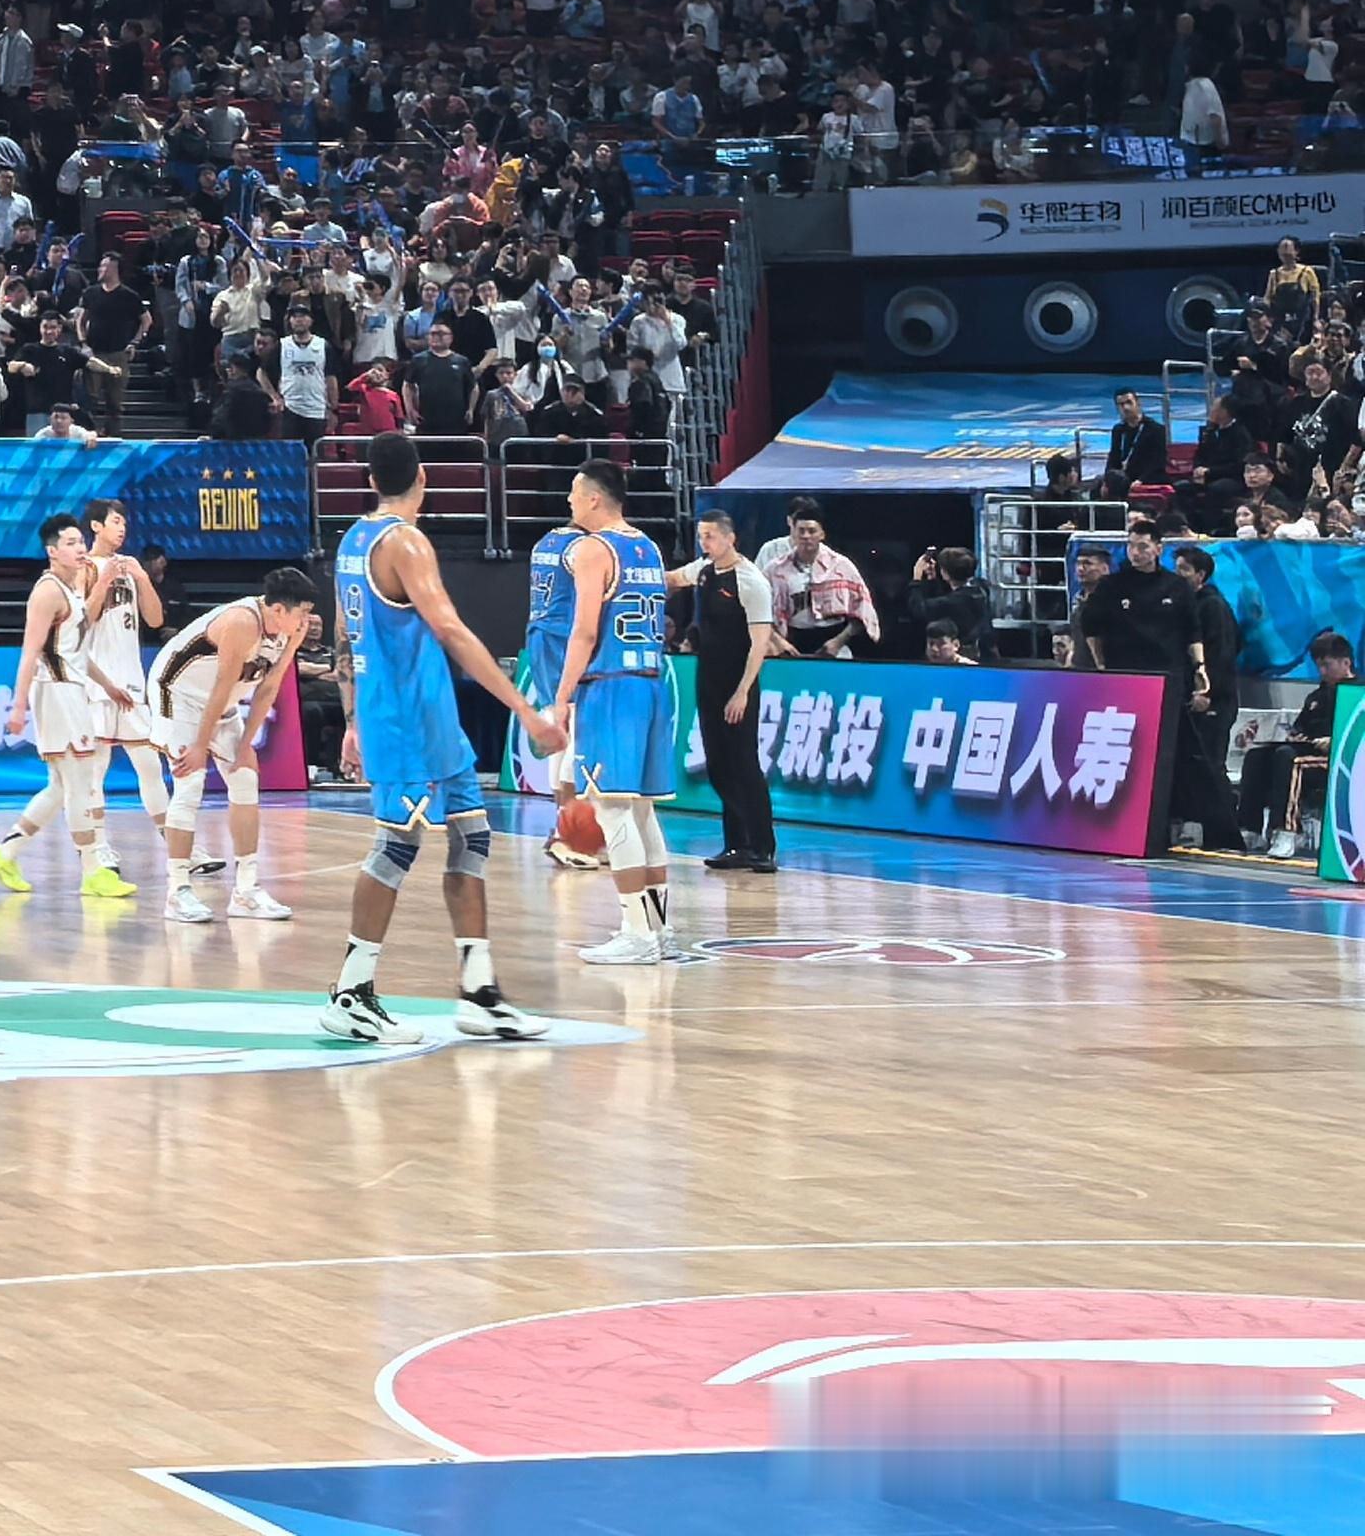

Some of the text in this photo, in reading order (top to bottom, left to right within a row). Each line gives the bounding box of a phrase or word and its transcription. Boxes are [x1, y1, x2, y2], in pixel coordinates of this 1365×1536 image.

[1019, 192, 1336, 224] 华熙生物 润百颜ECM中心
[198, 487, 260, 532] BEIJING
[901, 697, 1138, 810] 中国人寿
